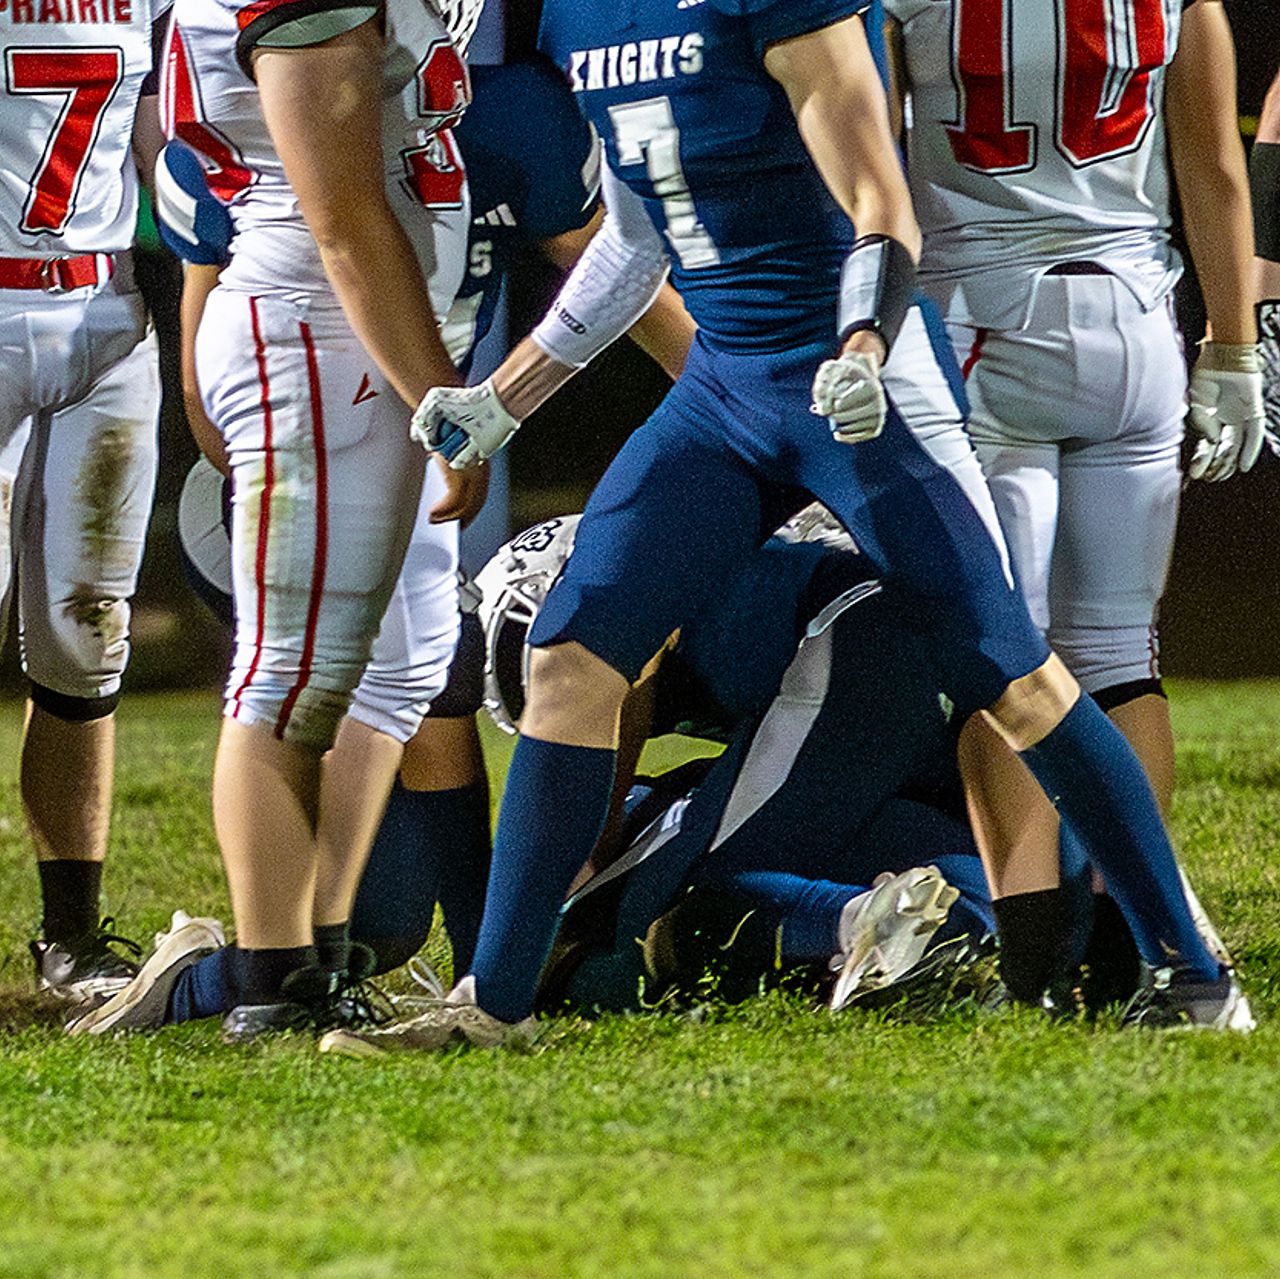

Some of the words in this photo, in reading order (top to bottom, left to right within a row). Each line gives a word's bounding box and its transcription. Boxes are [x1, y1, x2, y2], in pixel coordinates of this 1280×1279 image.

[3, 45, 125, 237] 7
[570, 32, 704, 92] KNIGHTS
[607, 95, 721, 270] 7
